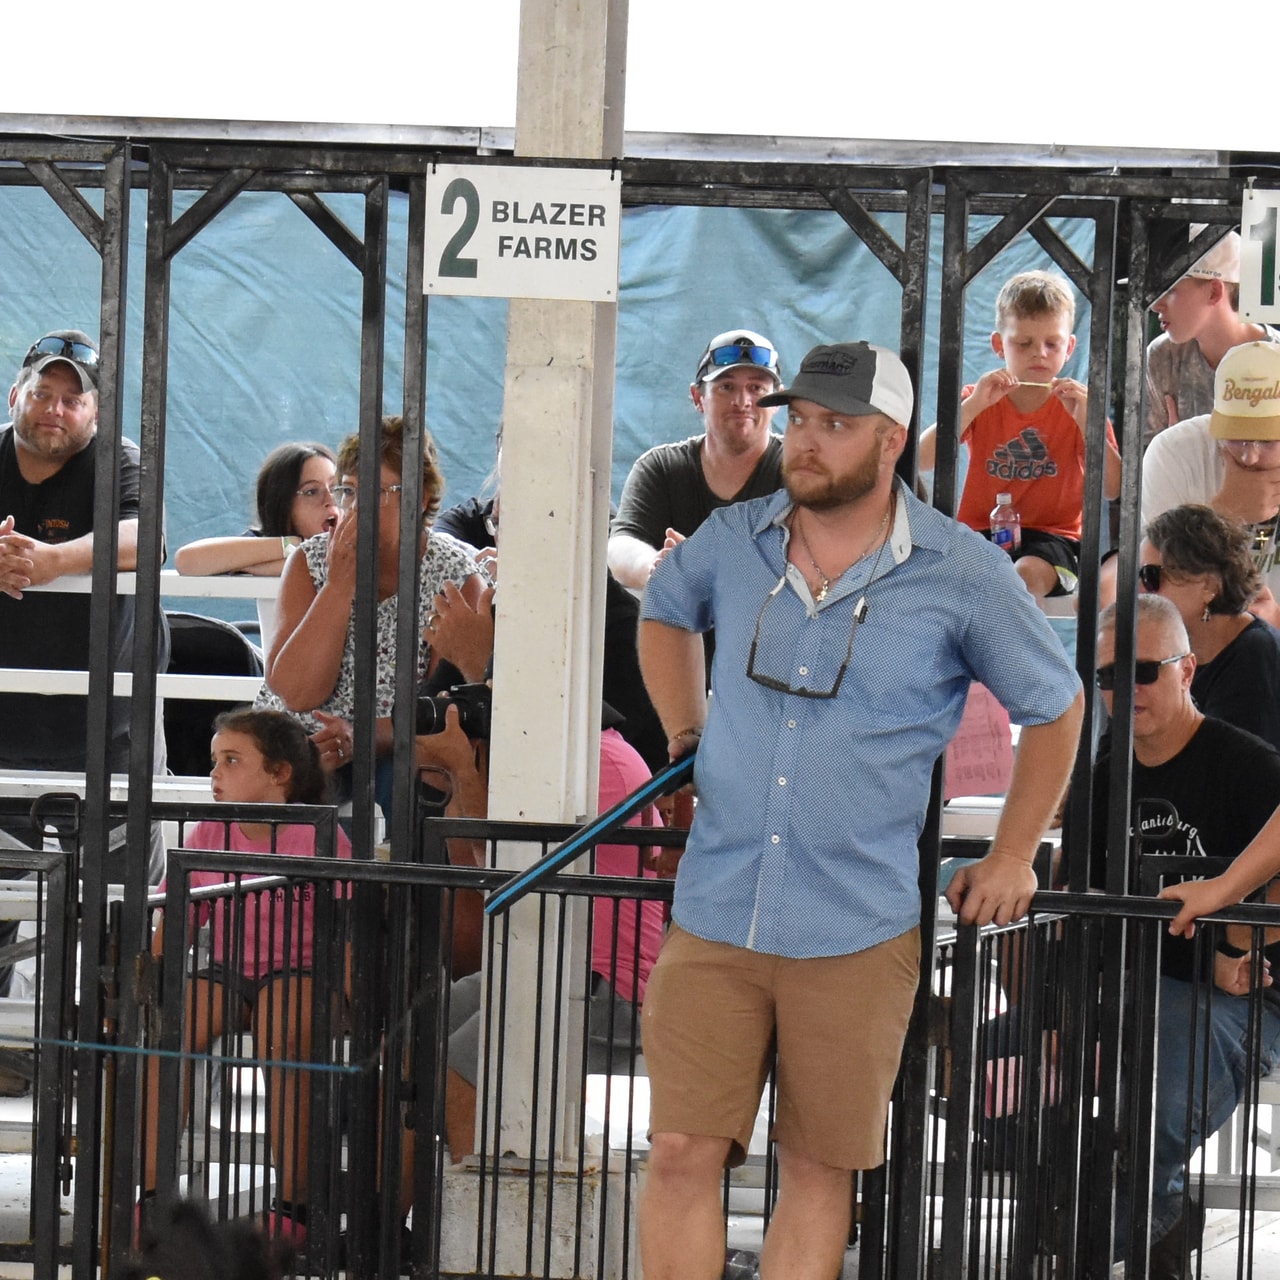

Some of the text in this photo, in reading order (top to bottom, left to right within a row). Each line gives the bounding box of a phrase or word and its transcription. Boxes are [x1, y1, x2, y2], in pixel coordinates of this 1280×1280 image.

[491, 200, 606, 227] BLAZER
[438, 177, 480, 278] 2
[498, 235, 598, 262] FARMS
[1249, 206, 1278, 306] 1
[985, 459, 1058, 481] adidas
